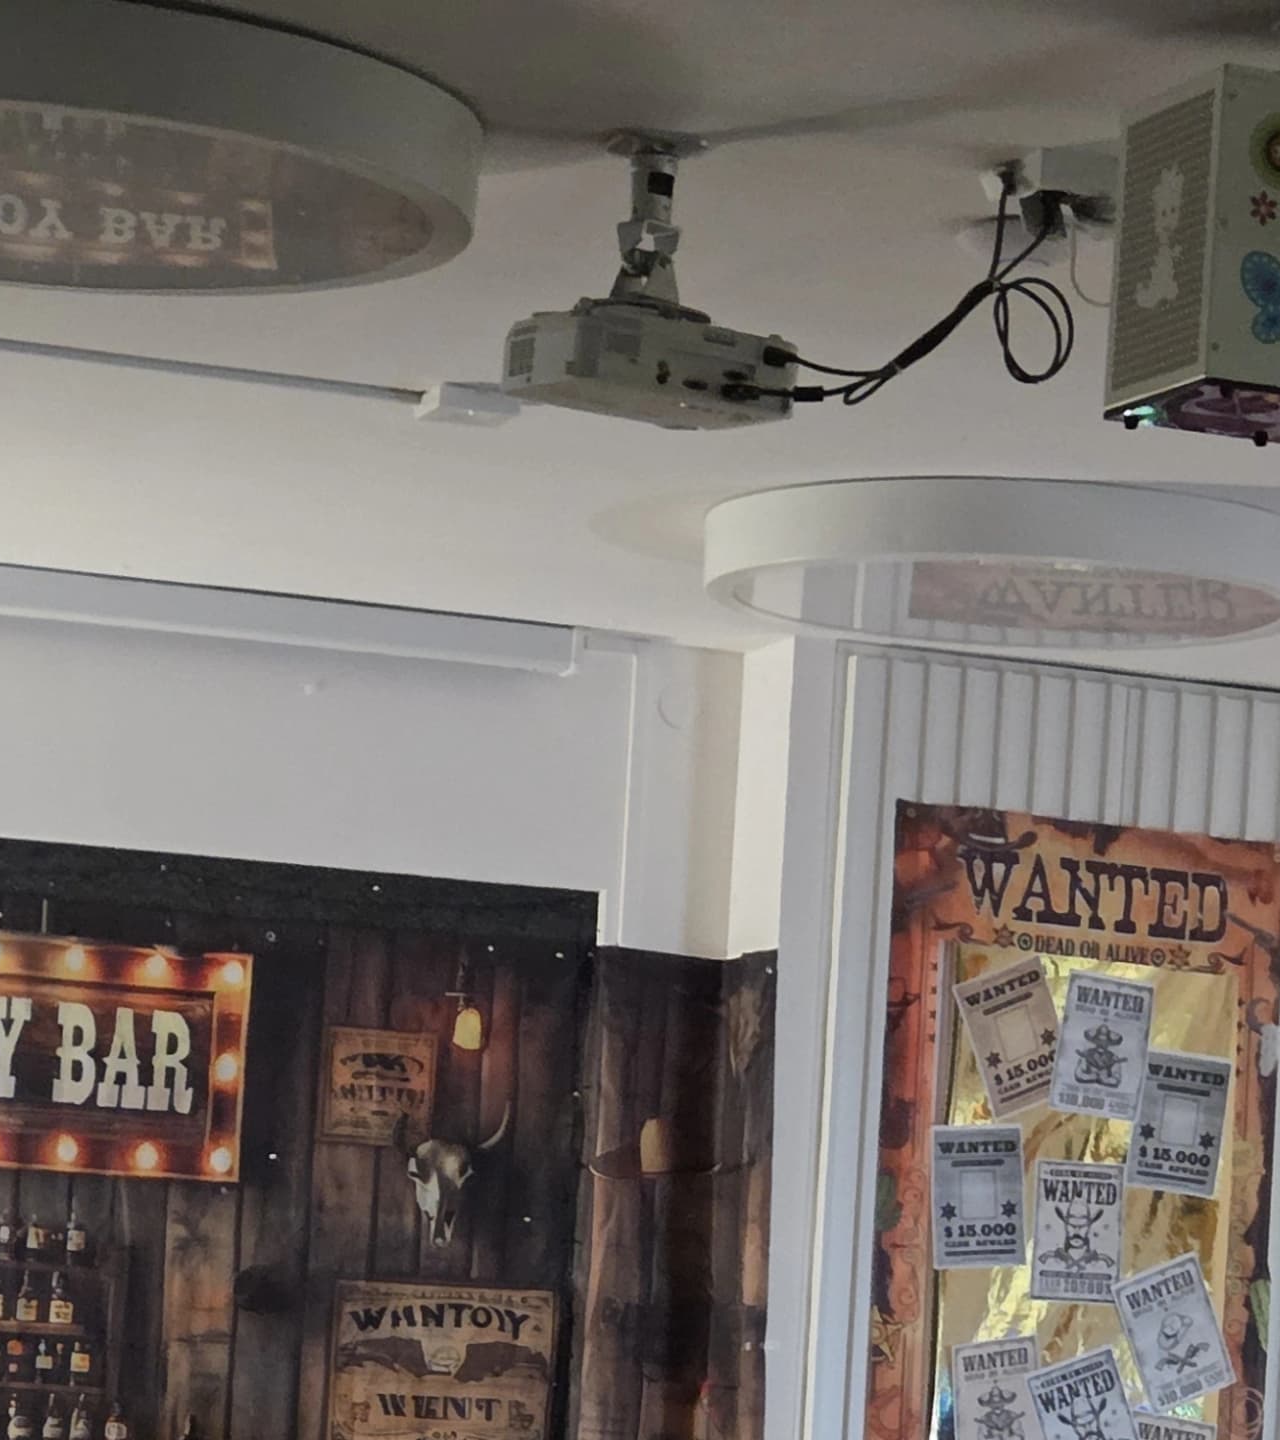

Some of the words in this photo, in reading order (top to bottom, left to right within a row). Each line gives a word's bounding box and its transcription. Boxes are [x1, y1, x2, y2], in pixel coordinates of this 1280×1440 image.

[957, 849, 1229, 943] WANTED
[1035, 934, 1075, 957] DEAD
[1106, 945, 1150, 964] ALIVE
[965, 969, 1041, 1007] WANTED
[1076, 985, 1145, 1014] WANTED
[51, 1001, 195, 1115] BAR
[1148, 1063, 1225, 1086] WANTED
[938, 1140, 1018, 1155] WANTED
[1043, 1178, 1118, 1206] WANTED
[1125, 1269, 1195, 1311] WANTED
[962, 1347, 1029, 1373] WANTED
[1037, 1368, 1116, 1414] WANTED
